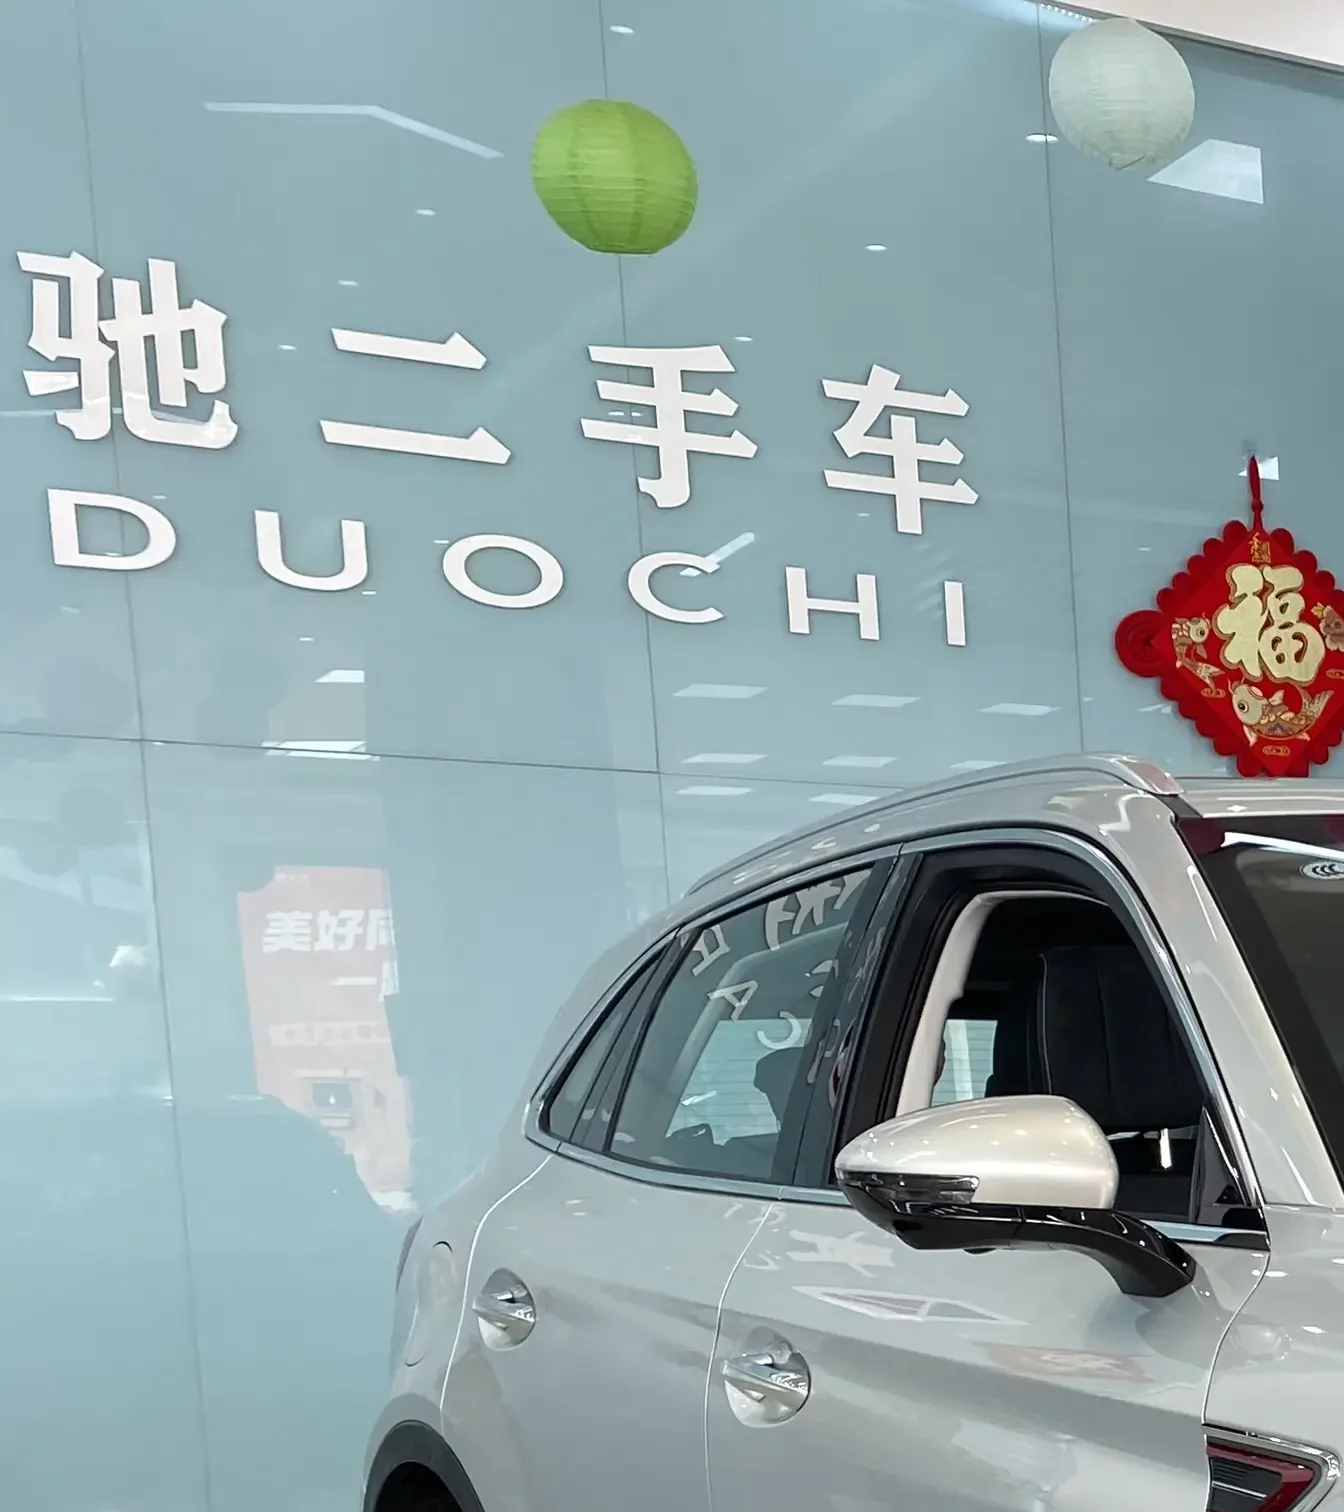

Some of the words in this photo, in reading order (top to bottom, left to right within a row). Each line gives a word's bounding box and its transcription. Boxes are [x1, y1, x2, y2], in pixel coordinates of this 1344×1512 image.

[17, 251, 979, 535] 驰二手车
[46, 487, 967, 647] DUOCHI
[1213, 564, 1325, 685] 福
